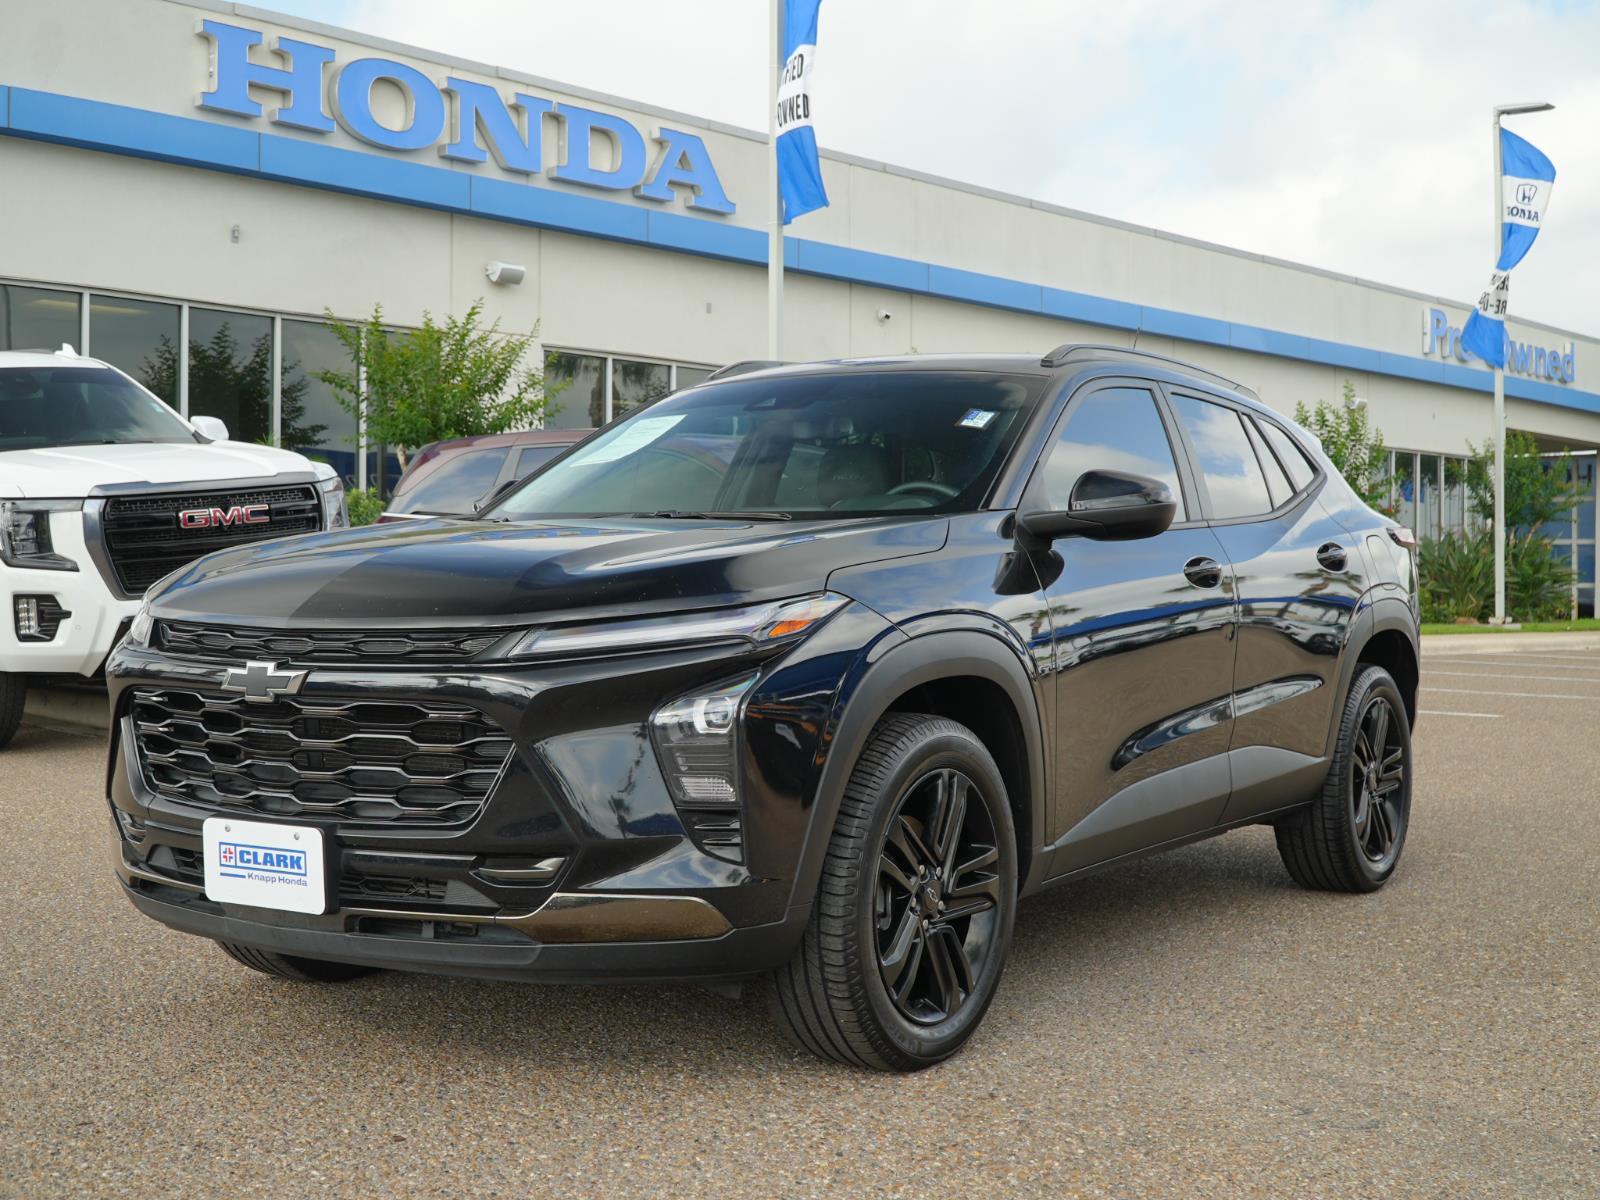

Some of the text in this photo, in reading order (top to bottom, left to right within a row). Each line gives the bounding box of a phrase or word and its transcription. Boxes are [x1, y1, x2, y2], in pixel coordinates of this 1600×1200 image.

[195, 19, 736, 216] HONDA
[777, 93, 810, 128] OWNED
[178, 503, 270, 529] GMC
[238, 849, 303, 870] CLARK
[247, 872, 308, 887] Knapp Honda
